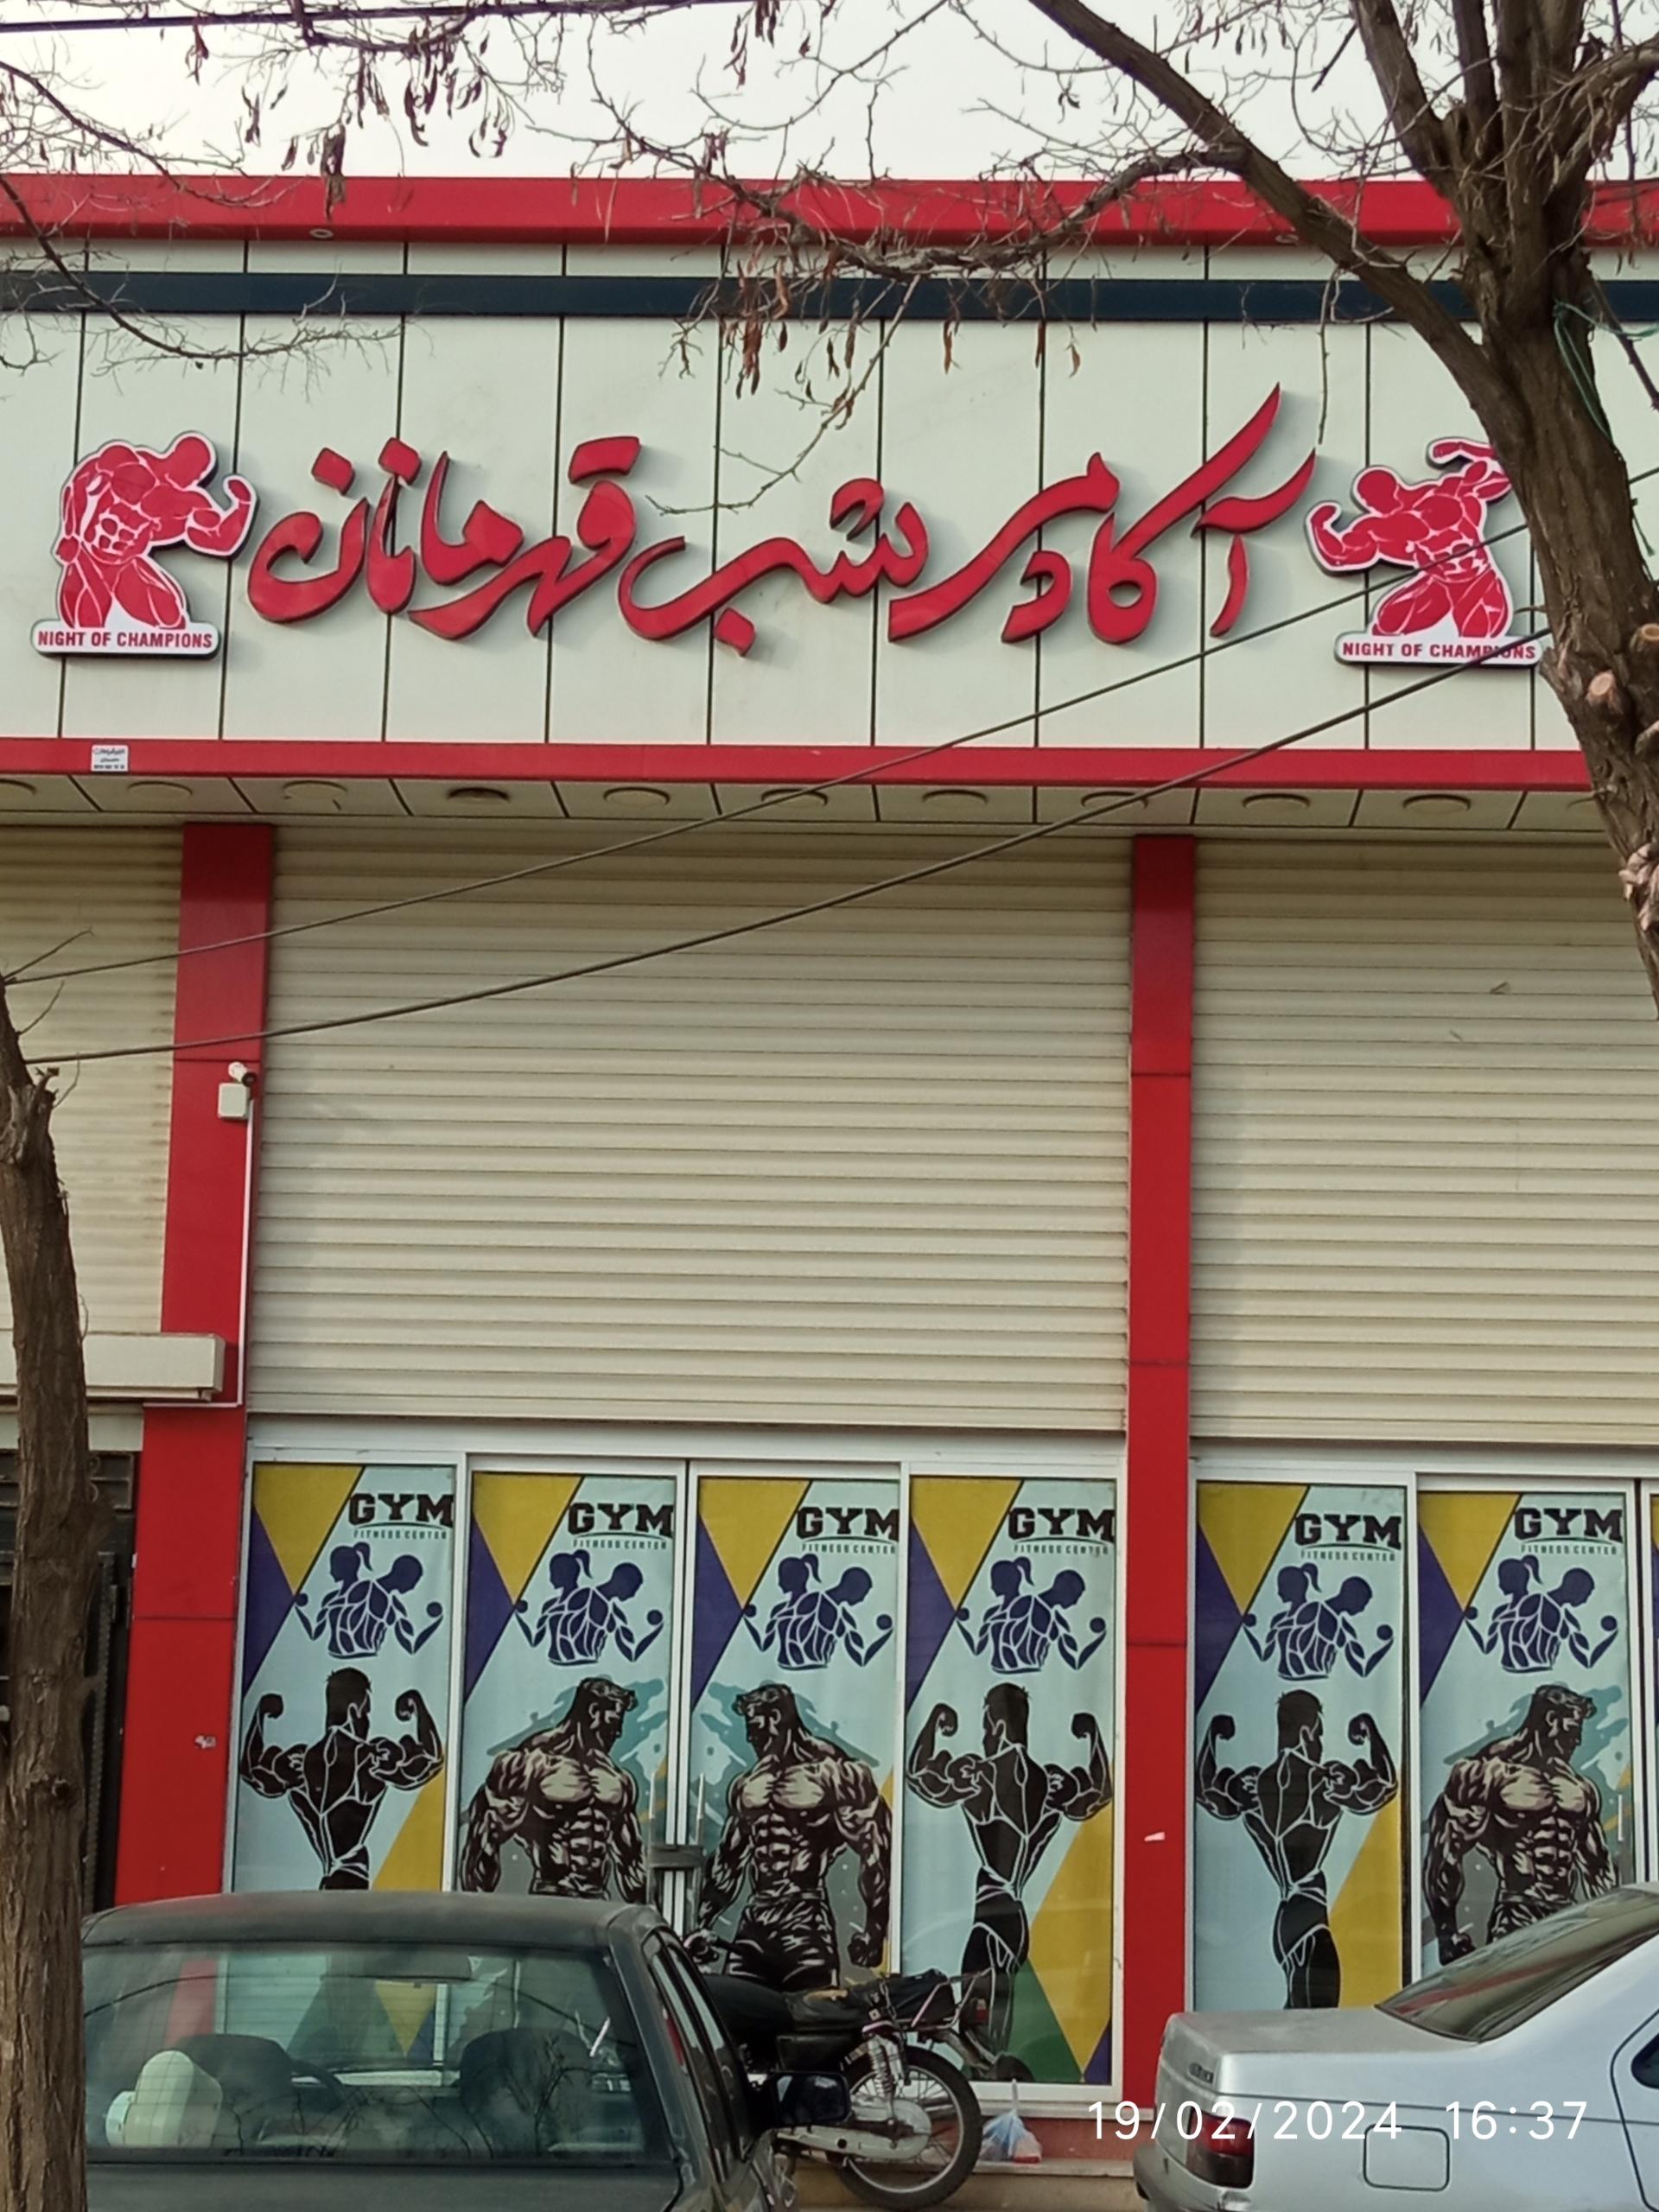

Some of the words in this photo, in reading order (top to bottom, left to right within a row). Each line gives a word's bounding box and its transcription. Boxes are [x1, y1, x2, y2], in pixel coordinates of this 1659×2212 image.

[888, 382, 1315, 646] آکادمی
[247, 436, 640, 640] قهرمانان
[617, 478, 929, 657] شب
[38, 631, 86, 646] NIGHT
[91, 632, 111, 647] OF
[117, 632, 213, 648] CHAMPIONS
[1342, 642, 1395, 657] NIGHT
[1401, 643, 1423, 657] OF
[348, 1493, 454, 1528] GYM
[568, 1503, 674, 1538] GYM
[797, 1507, 899, 1542] GYM
[1008, 1508, 1115, 1543] GYM
[1515, 1508, 1623, 1544] GYM
[1295, 1514, 1402, 1550] GYM
